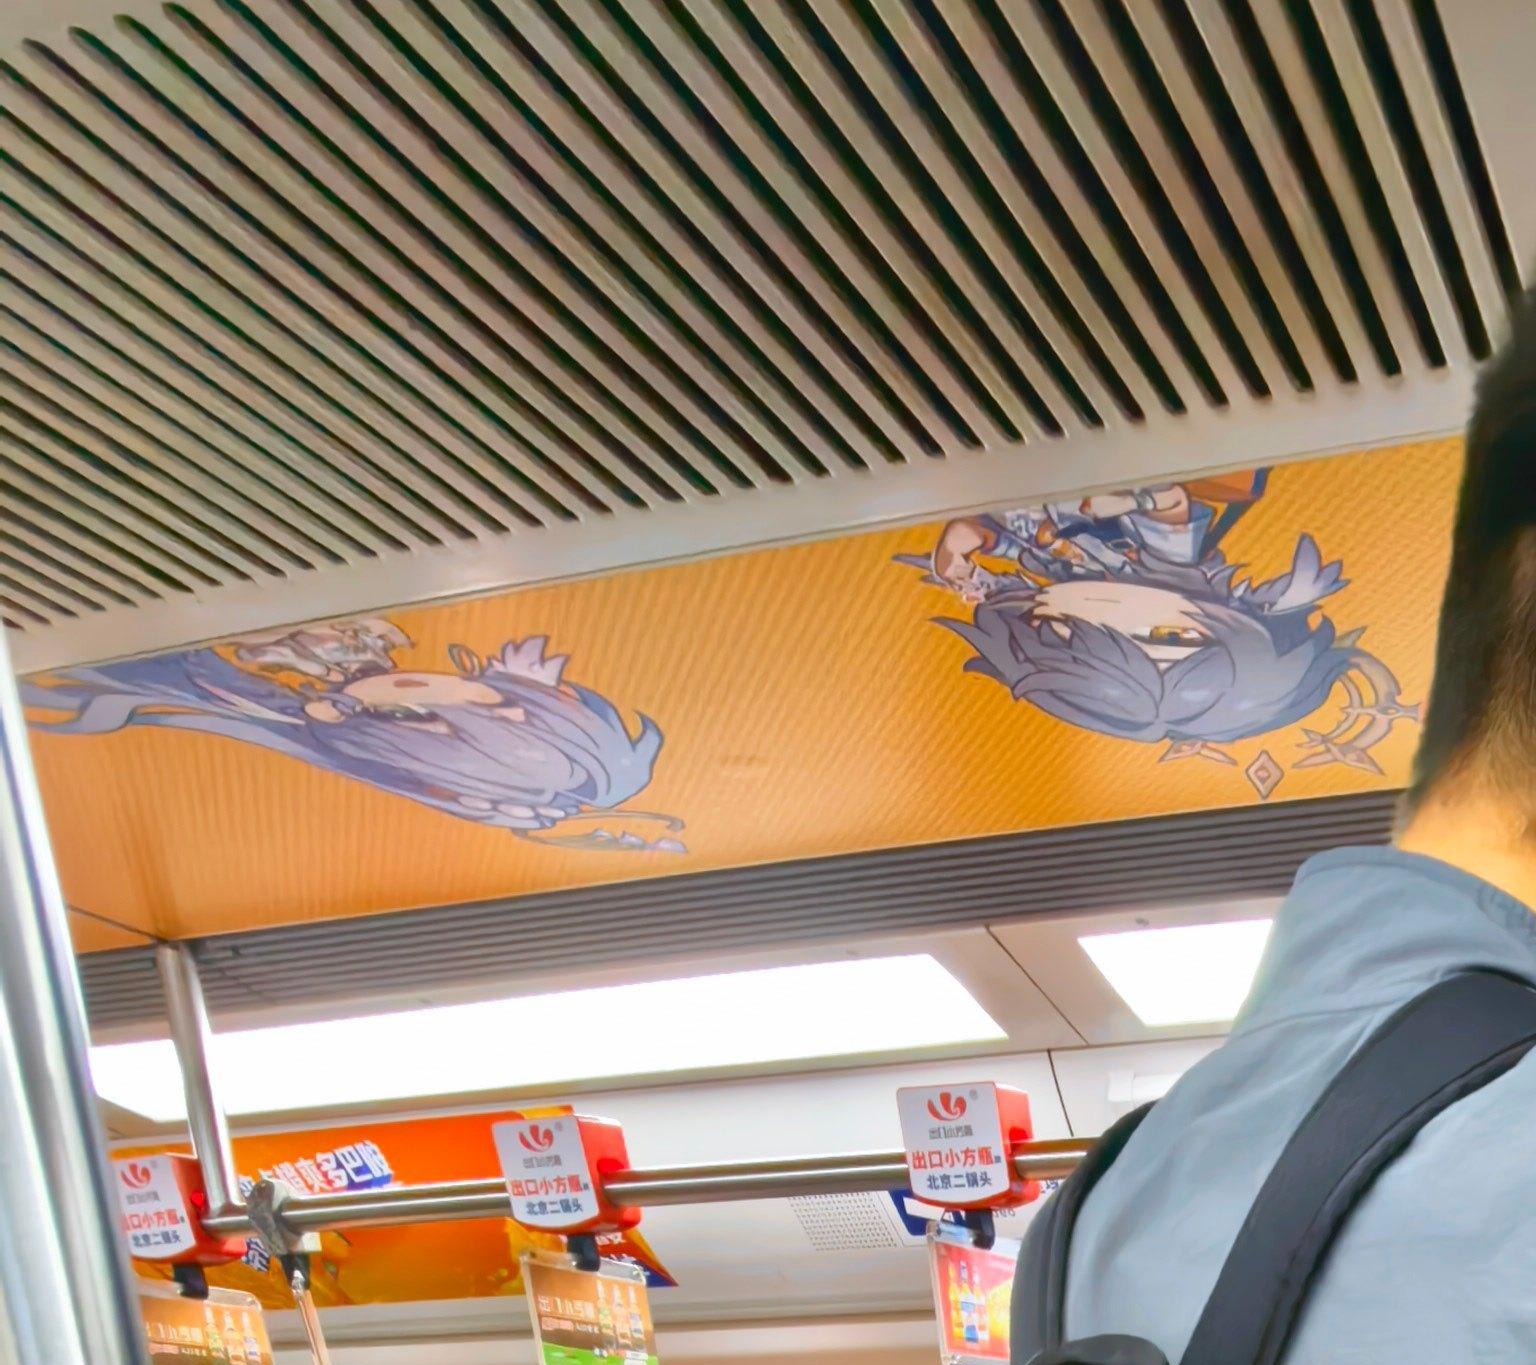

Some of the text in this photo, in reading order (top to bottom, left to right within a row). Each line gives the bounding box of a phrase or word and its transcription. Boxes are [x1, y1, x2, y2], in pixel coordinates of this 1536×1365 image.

[926, 1171, 992, 1190] 北京二锅头
